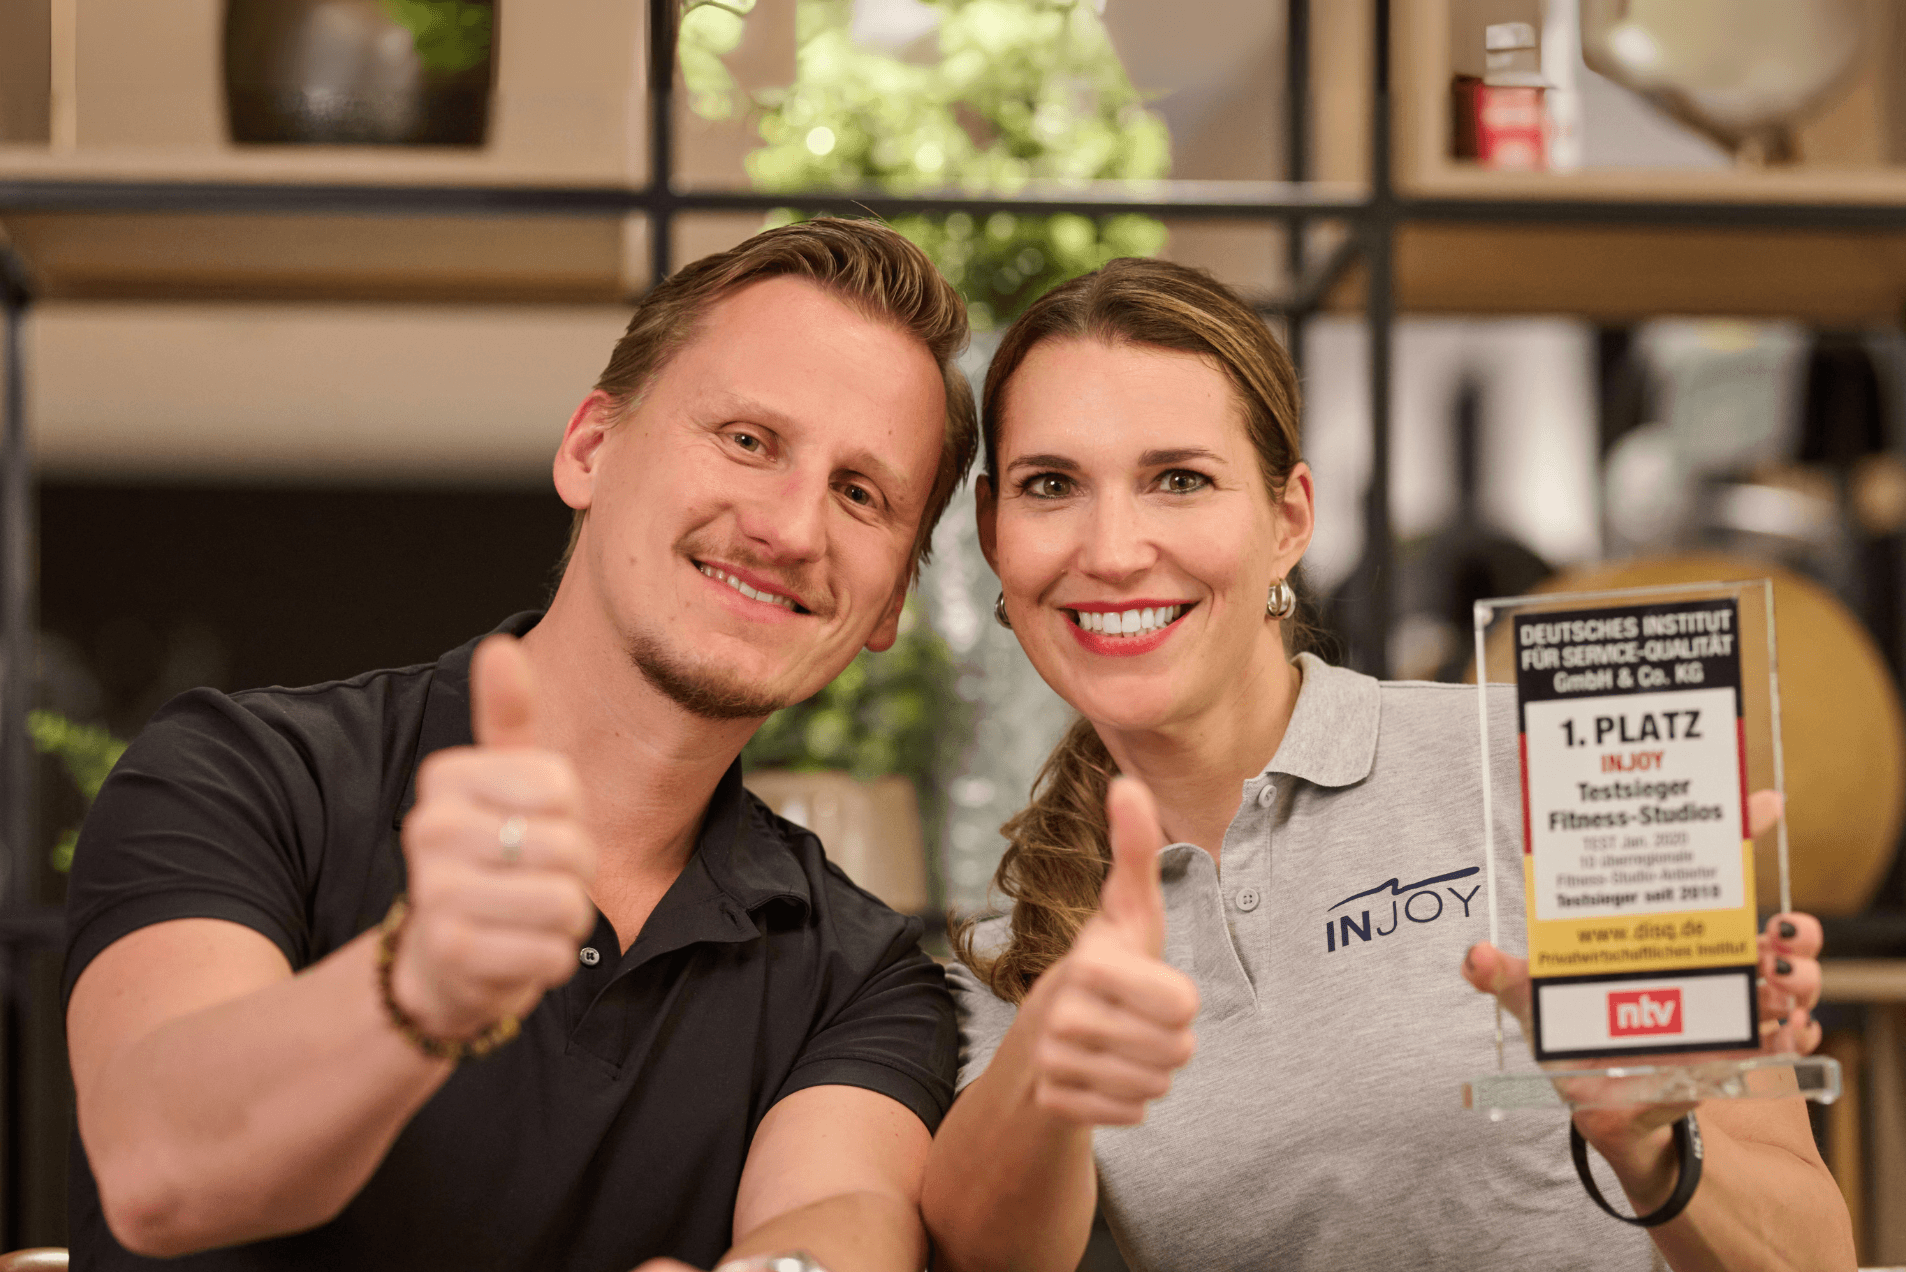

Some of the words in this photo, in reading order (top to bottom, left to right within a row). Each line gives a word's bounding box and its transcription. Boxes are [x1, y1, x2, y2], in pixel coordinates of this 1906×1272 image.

[1520, 616, 1639, 646] DEUTSCHES
[1642, 608, 1733, 637] INSTITUT
[1521, 645, 1560, 671] FÜR
[1561, 632, 1734, 668] SERVICE-QUALITÄT
[1553, 668, 1614, 693] GmbH
[1616, 666, 1635, 689] &
[1637, 664, 1671, 688] Co.
[1674, 661, 1704, 684] KG
[1561, 719, 1586, 747] 1.
[1595, 710, 1703, 745] PLATZ
[1600, 751, 1664, 773] INJOY
[1577, 779, 1690, 803] Testsieger
[1548, 803, 1722, 831] Fitness-Studios
[1326, 885, 1481, 953] INJOY
[1616, 995, 1675, 1029] ntv
